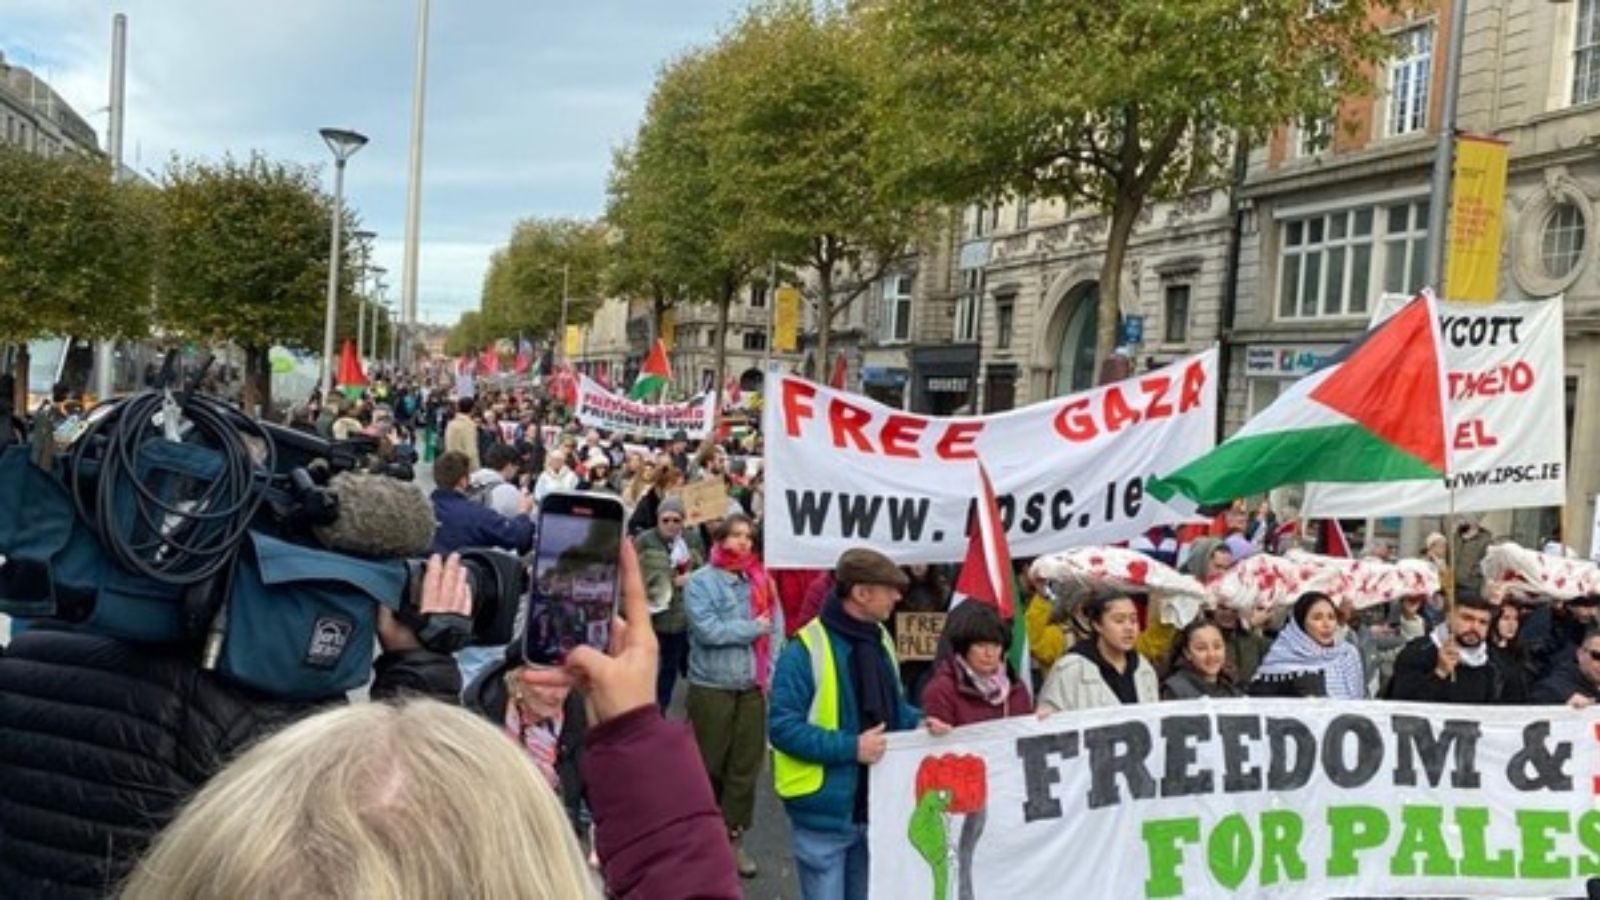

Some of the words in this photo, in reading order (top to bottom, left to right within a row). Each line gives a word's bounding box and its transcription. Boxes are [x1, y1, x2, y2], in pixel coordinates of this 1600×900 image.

[781, 377, 985, 460] FREE
[1053, 360, 1206, 443] GAZA
[1017, 714, 1482, 822] FREEDOM
[1506, 719, 1574, 792] &
[1141, 808, 1307, 900] FOR
